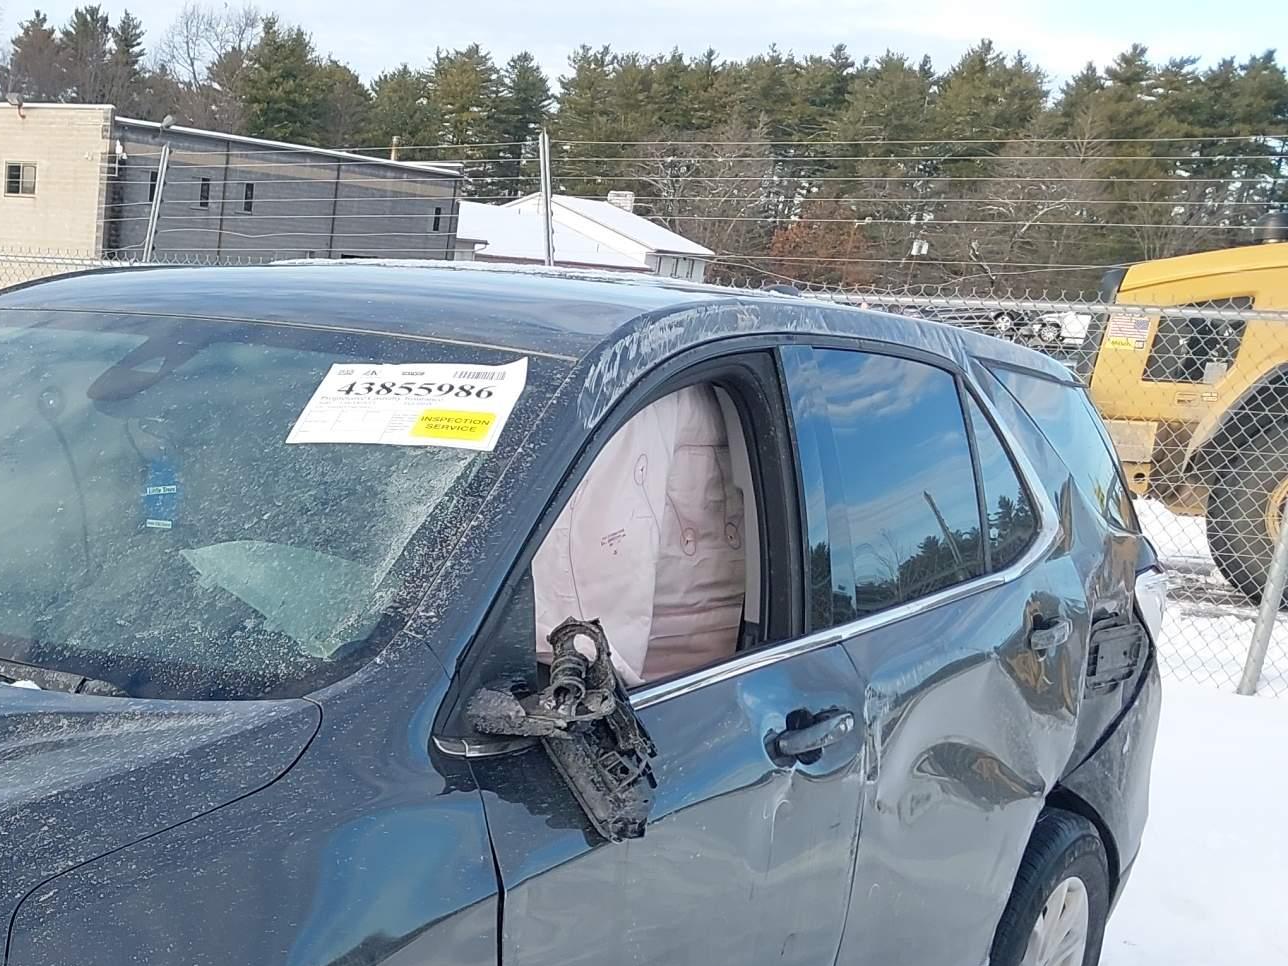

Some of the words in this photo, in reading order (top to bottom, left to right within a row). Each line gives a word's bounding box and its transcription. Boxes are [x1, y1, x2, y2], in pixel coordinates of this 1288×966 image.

[337, 380, 497, 399] 43855986
[420, 415, 491, 426] INSPECTION
[425, 423, 477, 432] SERVICE
